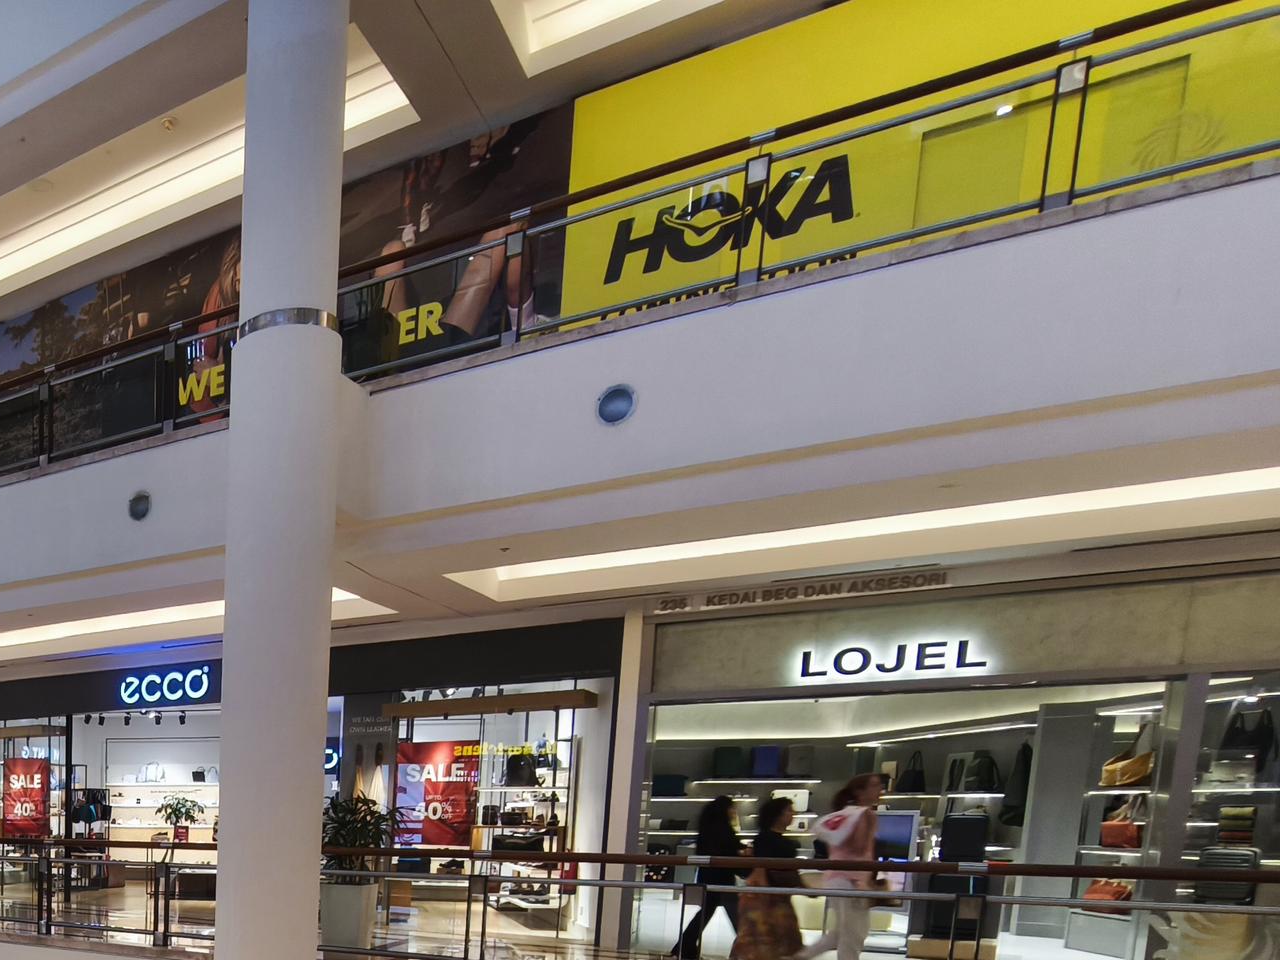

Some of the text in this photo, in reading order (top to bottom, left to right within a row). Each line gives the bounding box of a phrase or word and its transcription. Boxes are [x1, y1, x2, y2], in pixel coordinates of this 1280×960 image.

[604, 154, 854, 285] HOKA
[178, 364, 225, 405] WE
[706, 590, 757, 607] KEDAI
[761, 586, 799, 602] BEG
[803, 582, 842, 598] DAN
[847, 571, 947, 593] AKSESORI
[800, 639, 987, 678] LOJEL
[120, 667, 209, 704] ecco
[10, 773, 41, 789] SALE
[406, 763, 464, 782] SALE
